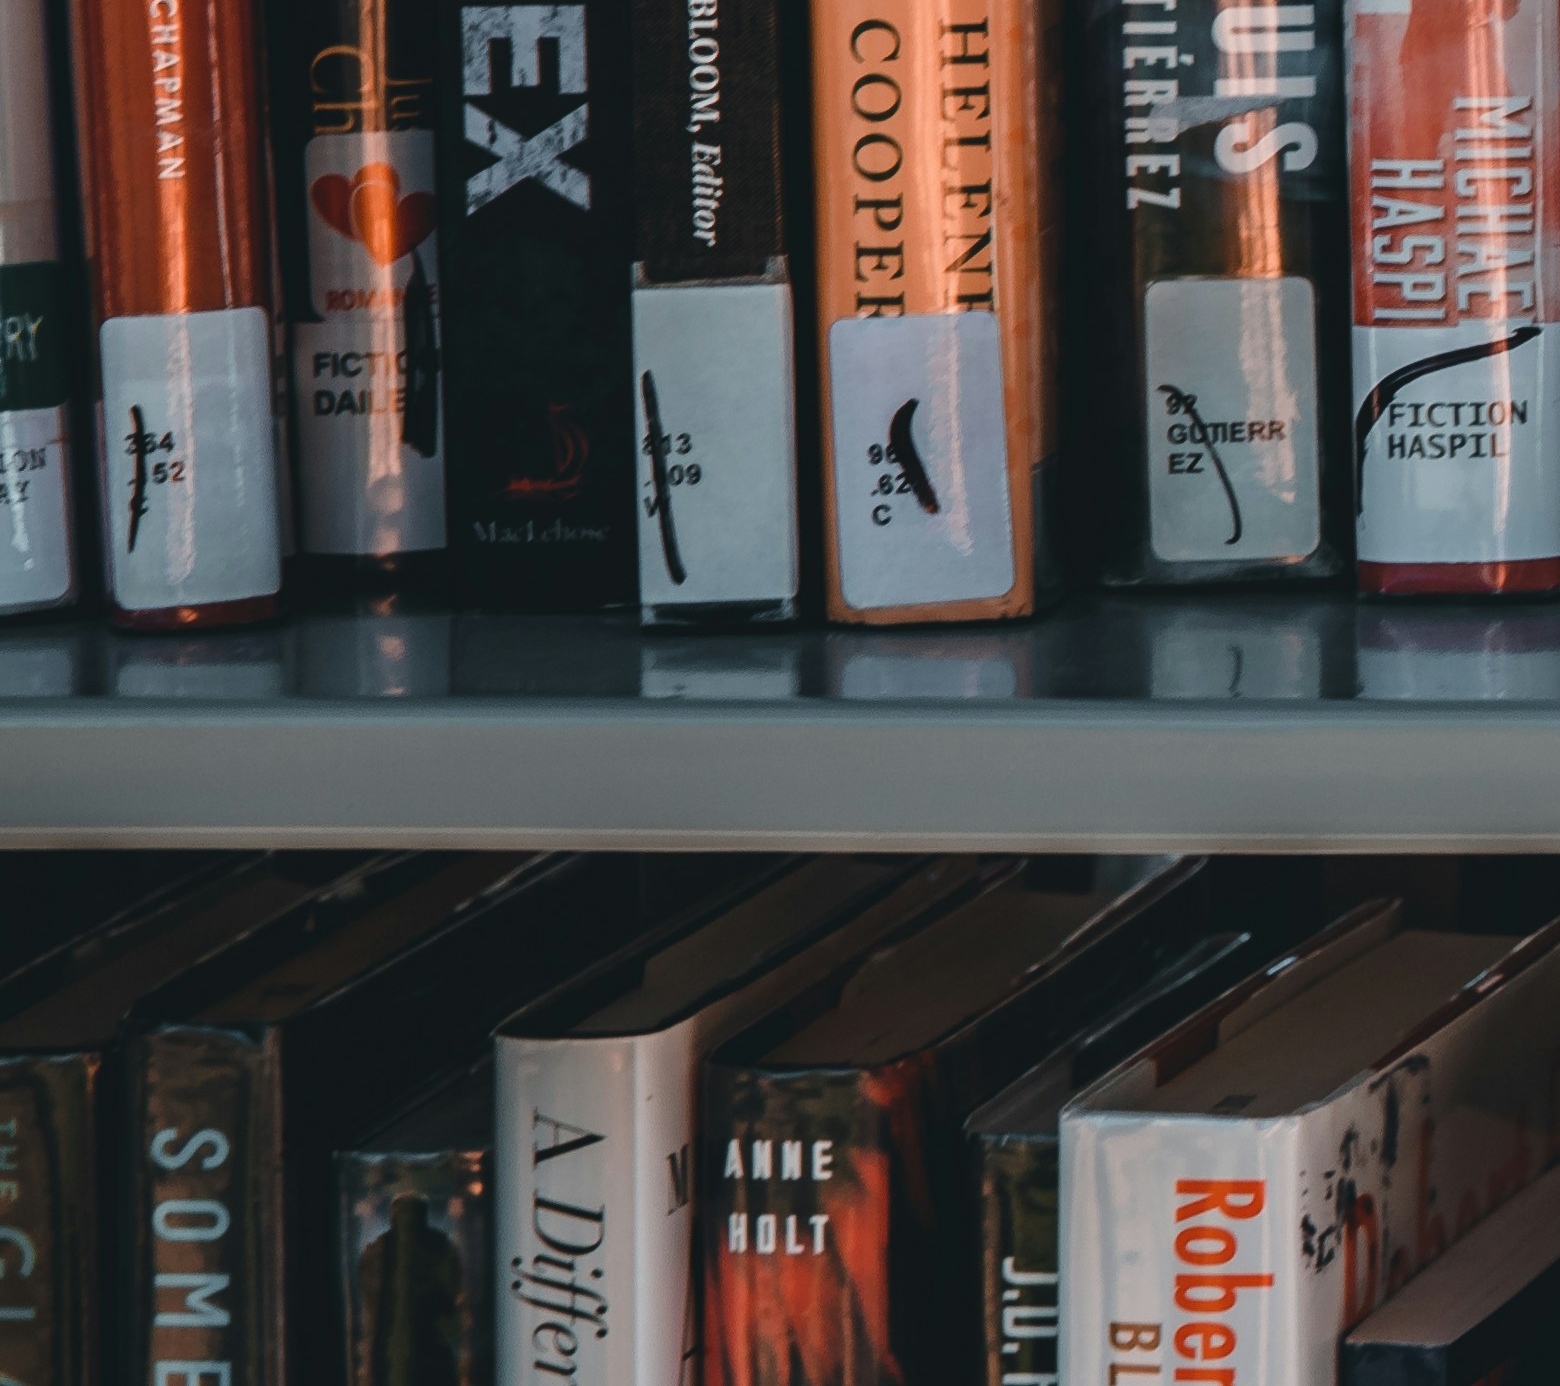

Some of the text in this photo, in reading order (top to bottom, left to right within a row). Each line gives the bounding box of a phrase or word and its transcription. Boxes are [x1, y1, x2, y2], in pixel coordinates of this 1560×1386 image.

[1389, 400, 1527, 427] FICTION
[1389, 433, 1509, 459] HASPIL
[531, 1108, 607, 1165] A
[724, 1139, 834, 1182] ANNE
[727, 1213, 830, 1256] HOLT
